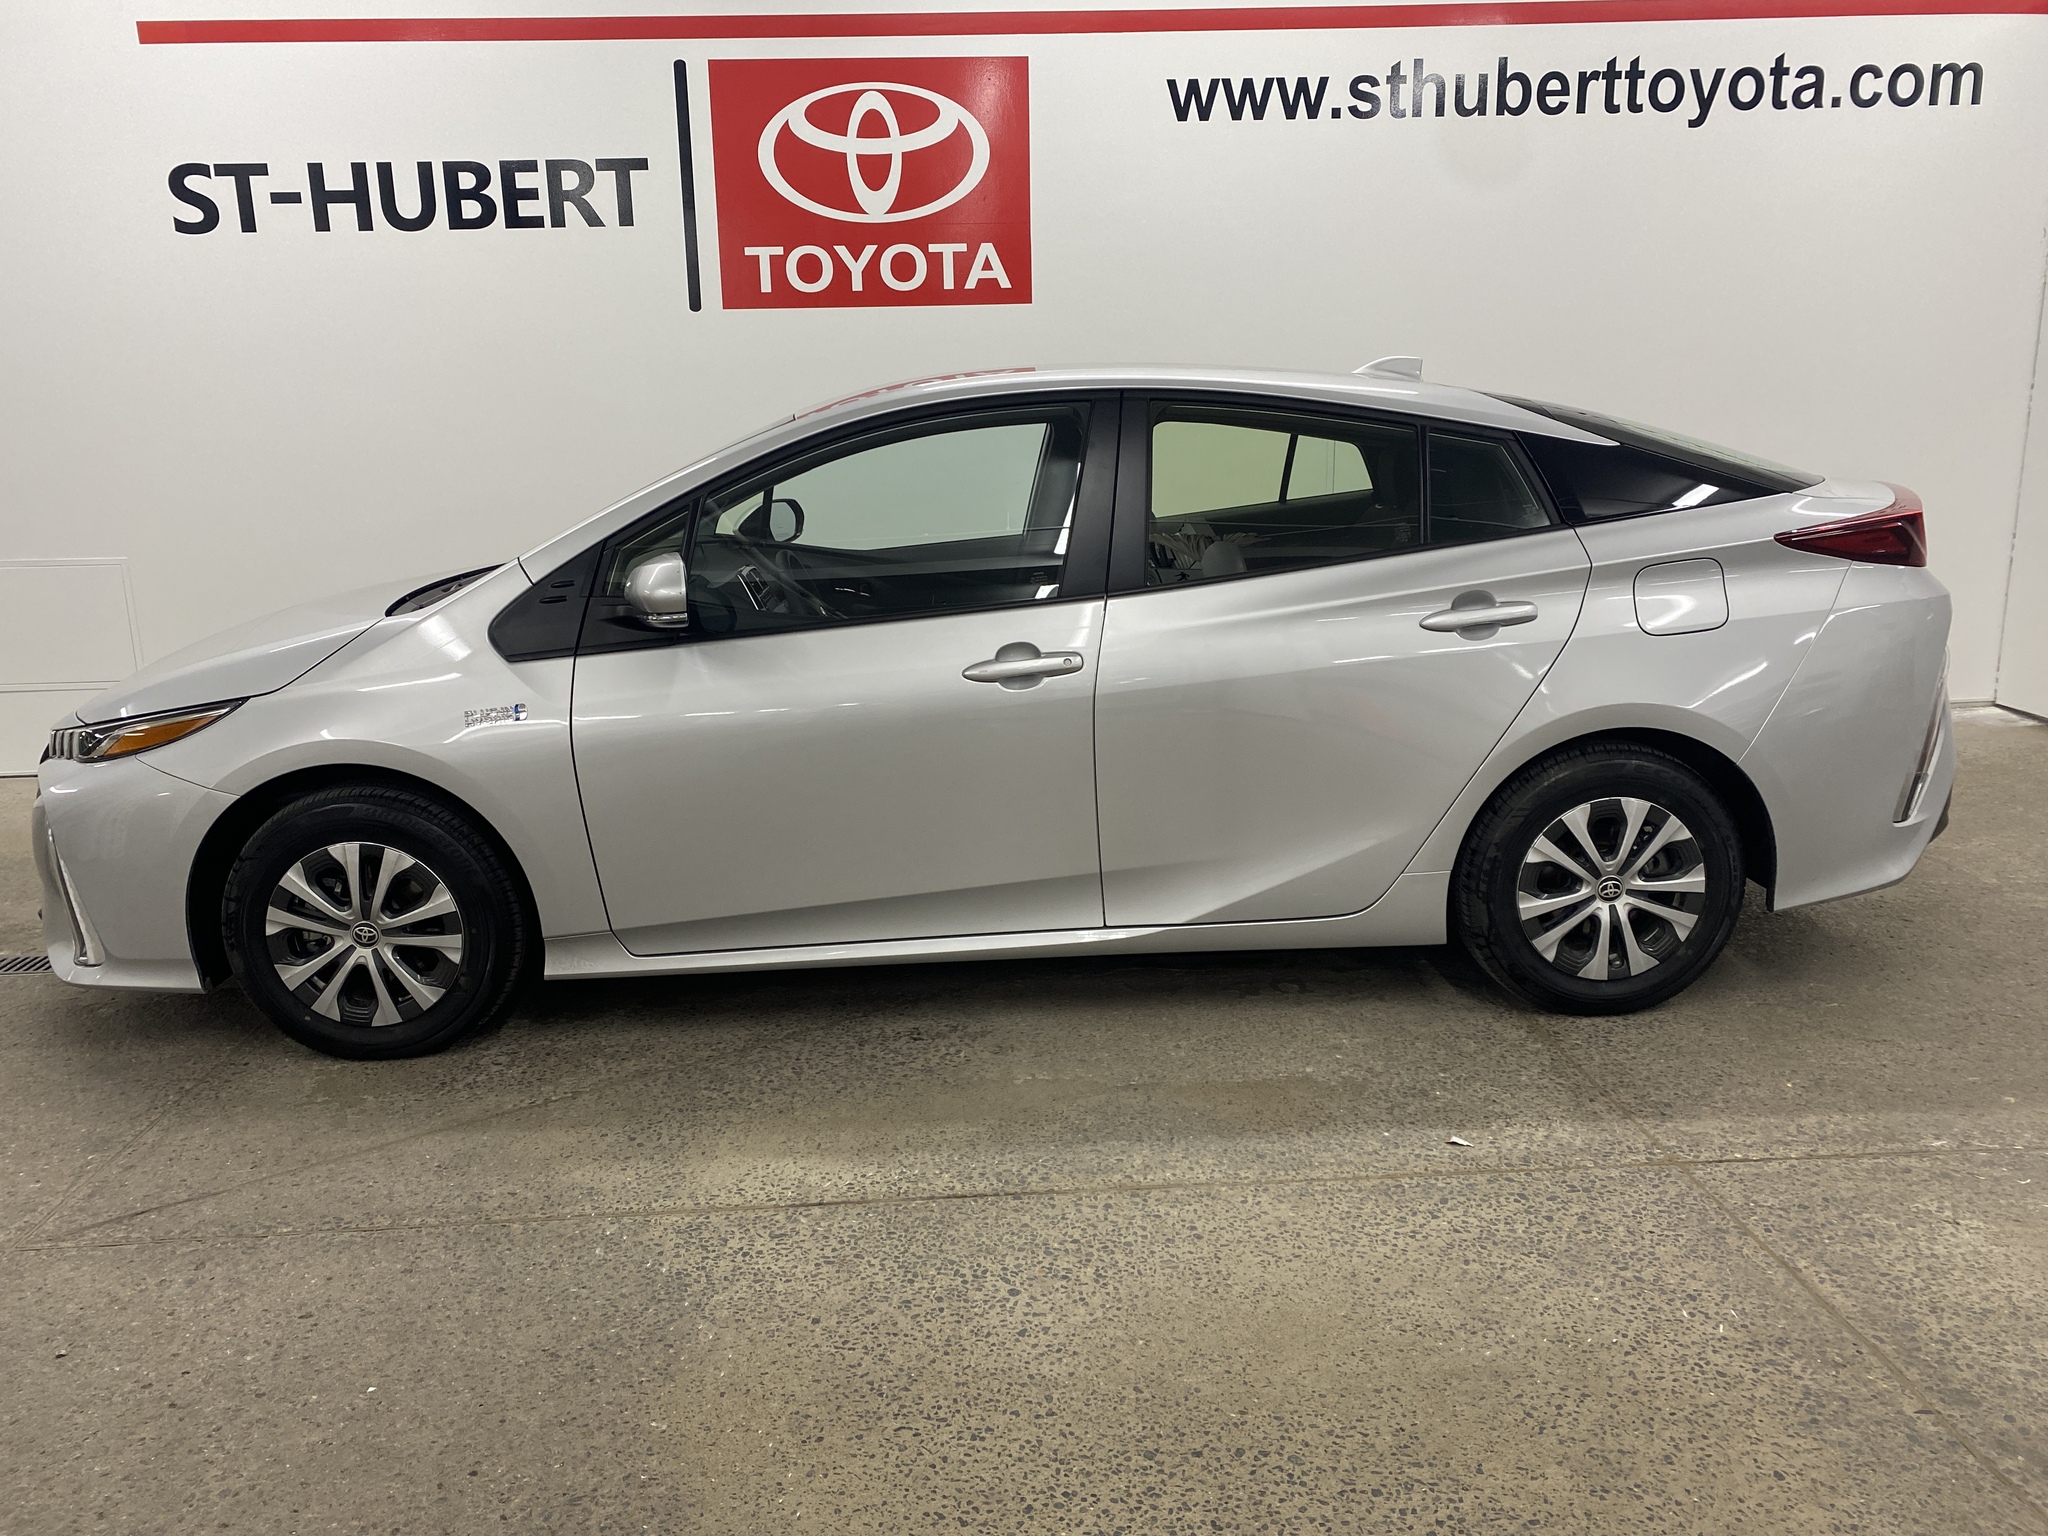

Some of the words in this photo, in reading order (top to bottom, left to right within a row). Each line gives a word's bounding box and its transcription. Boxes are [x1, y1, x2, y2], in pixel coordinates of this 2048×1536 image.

[1167, 52, 1984, 129] www.sthuberttoyota.com
[168, 157, 649, 235] ST-HUBERT
[744, 242, 1012, 293] TOYOTA
